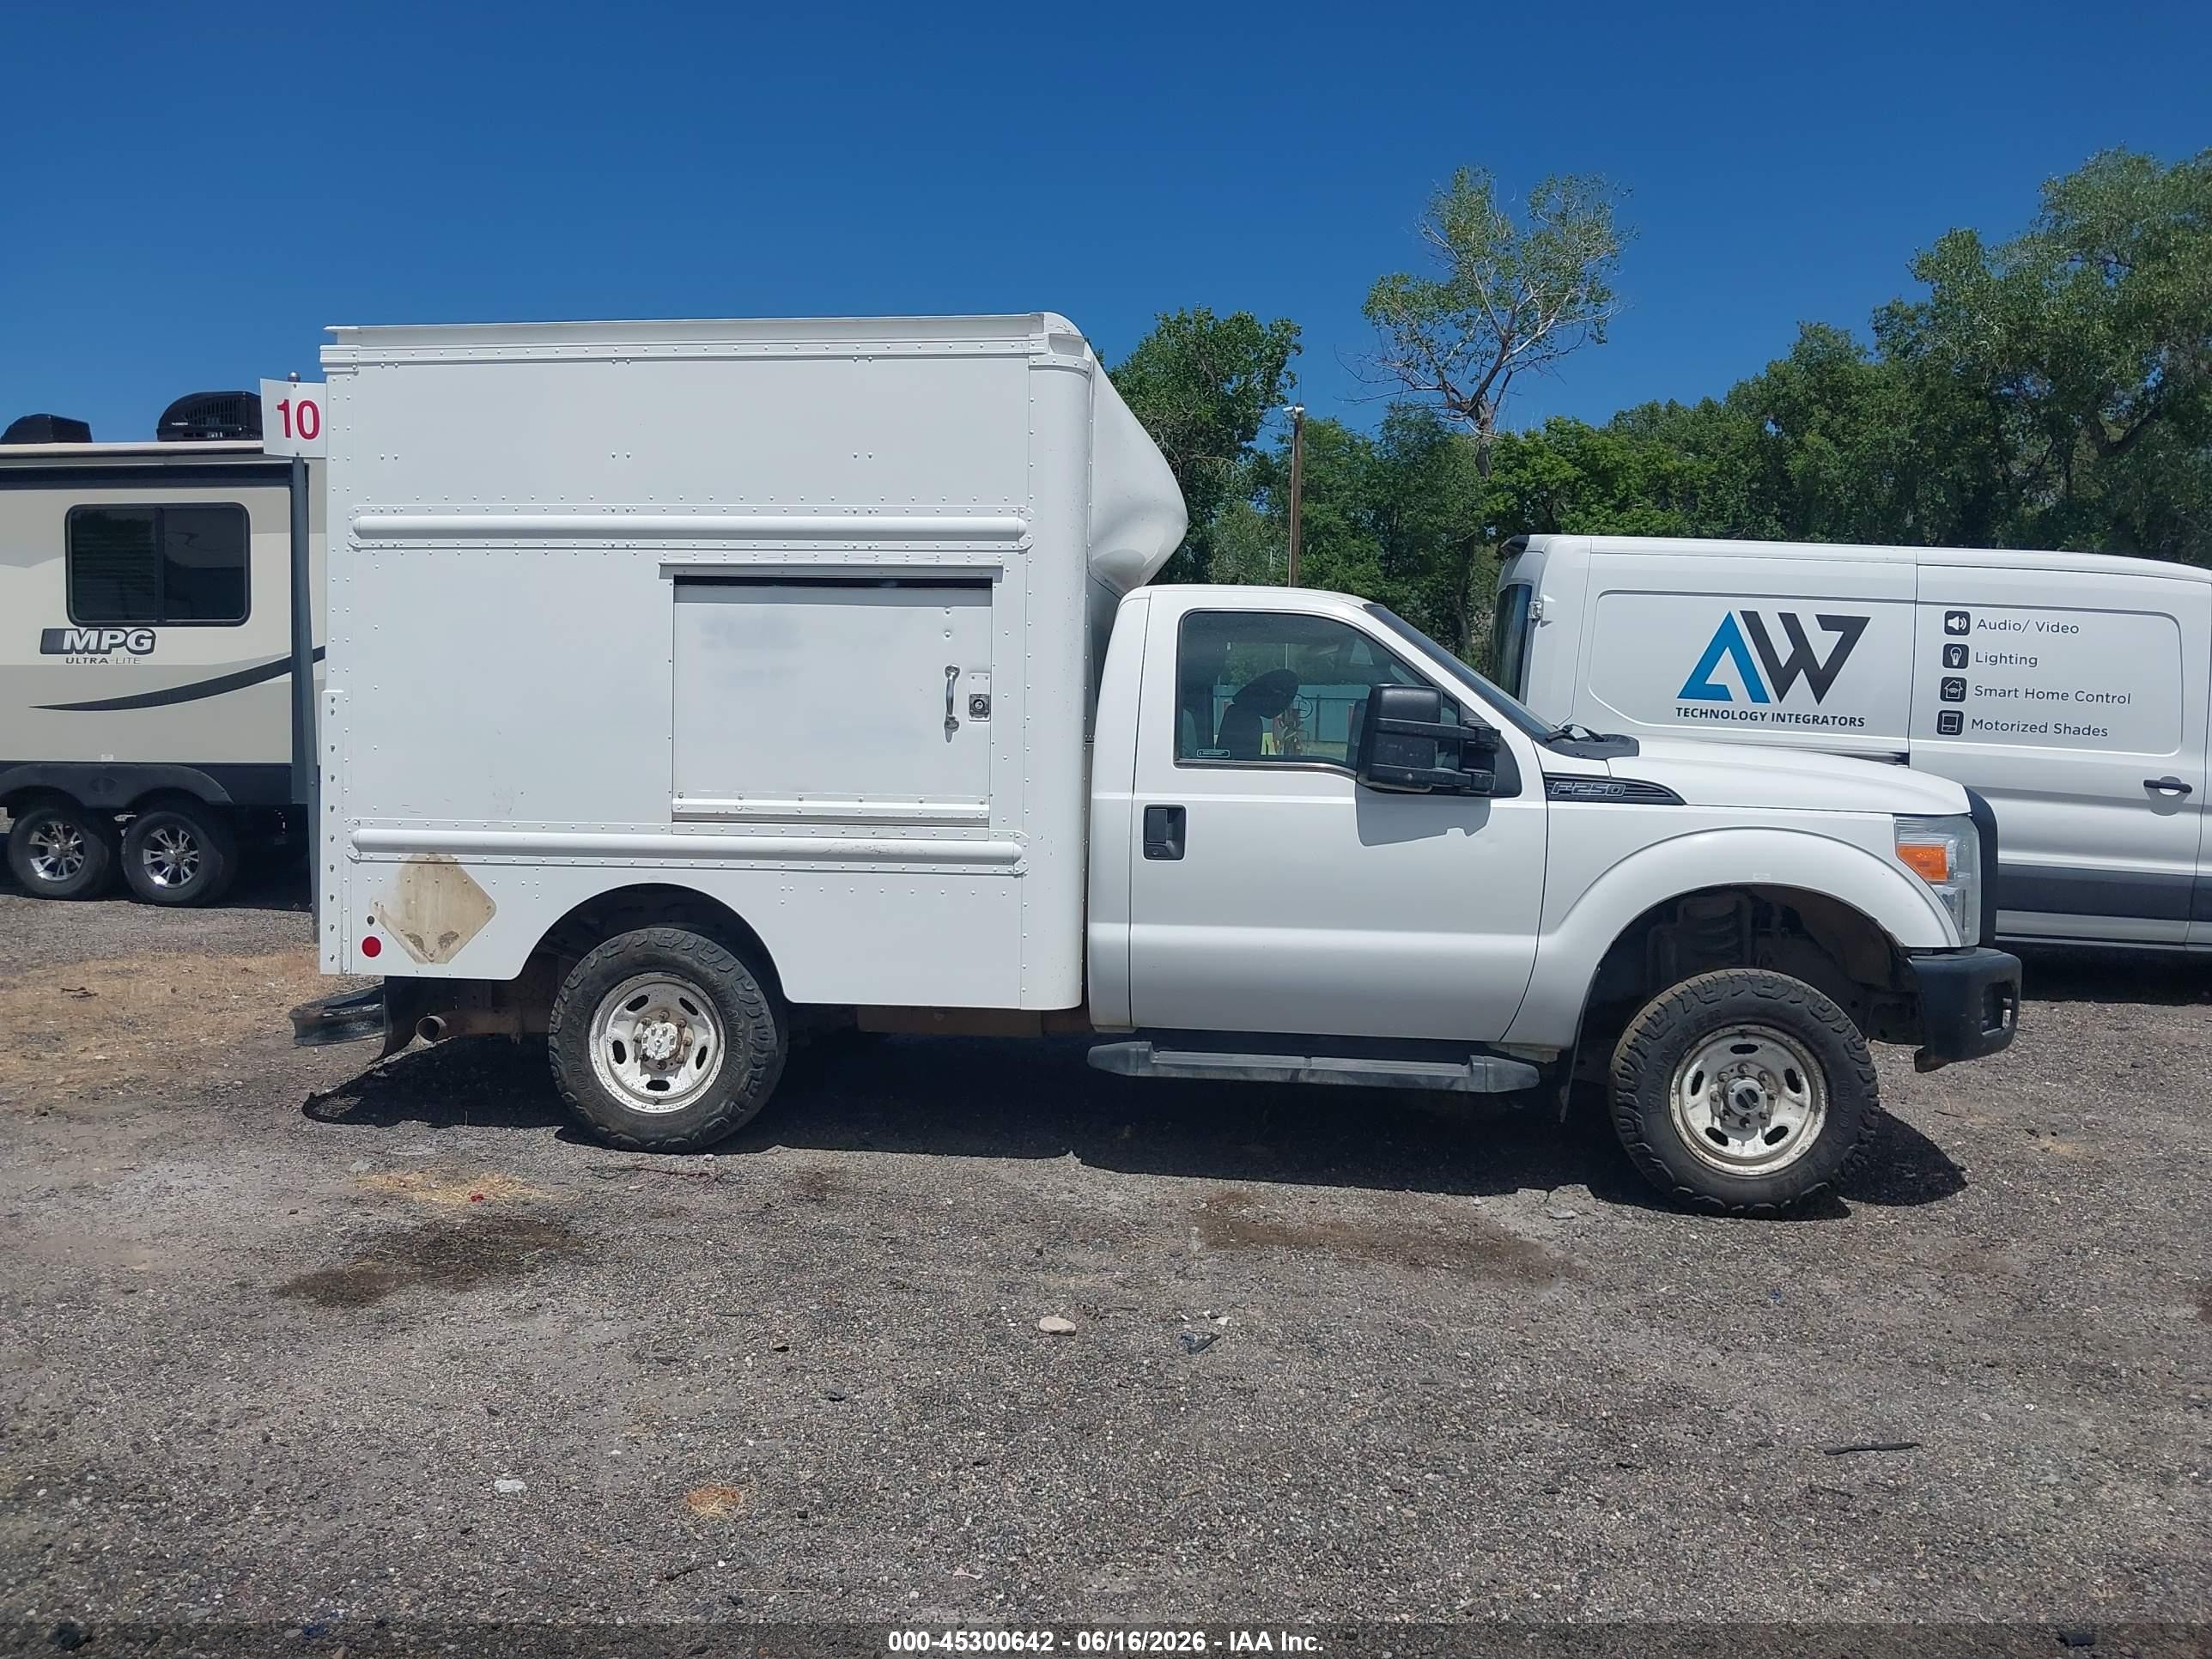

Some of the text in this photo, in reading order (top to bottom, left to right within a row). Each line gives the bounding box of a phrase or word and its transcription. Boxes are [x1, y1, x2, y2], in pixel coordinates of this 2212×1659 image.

[276, 398, 320, 441] 10
[2035, 621, 2080, 634] Video
[63, 629, 154, 651] MPG
[1975, 652, 2039, 667] Lighting
[1974, 685, 2131, 704] Smart Home Control
[1675, 707, 1866, 727] TECHNOLOGY INTEGRATORS
[1971, 719, 2108, 737] Motorized Shades
